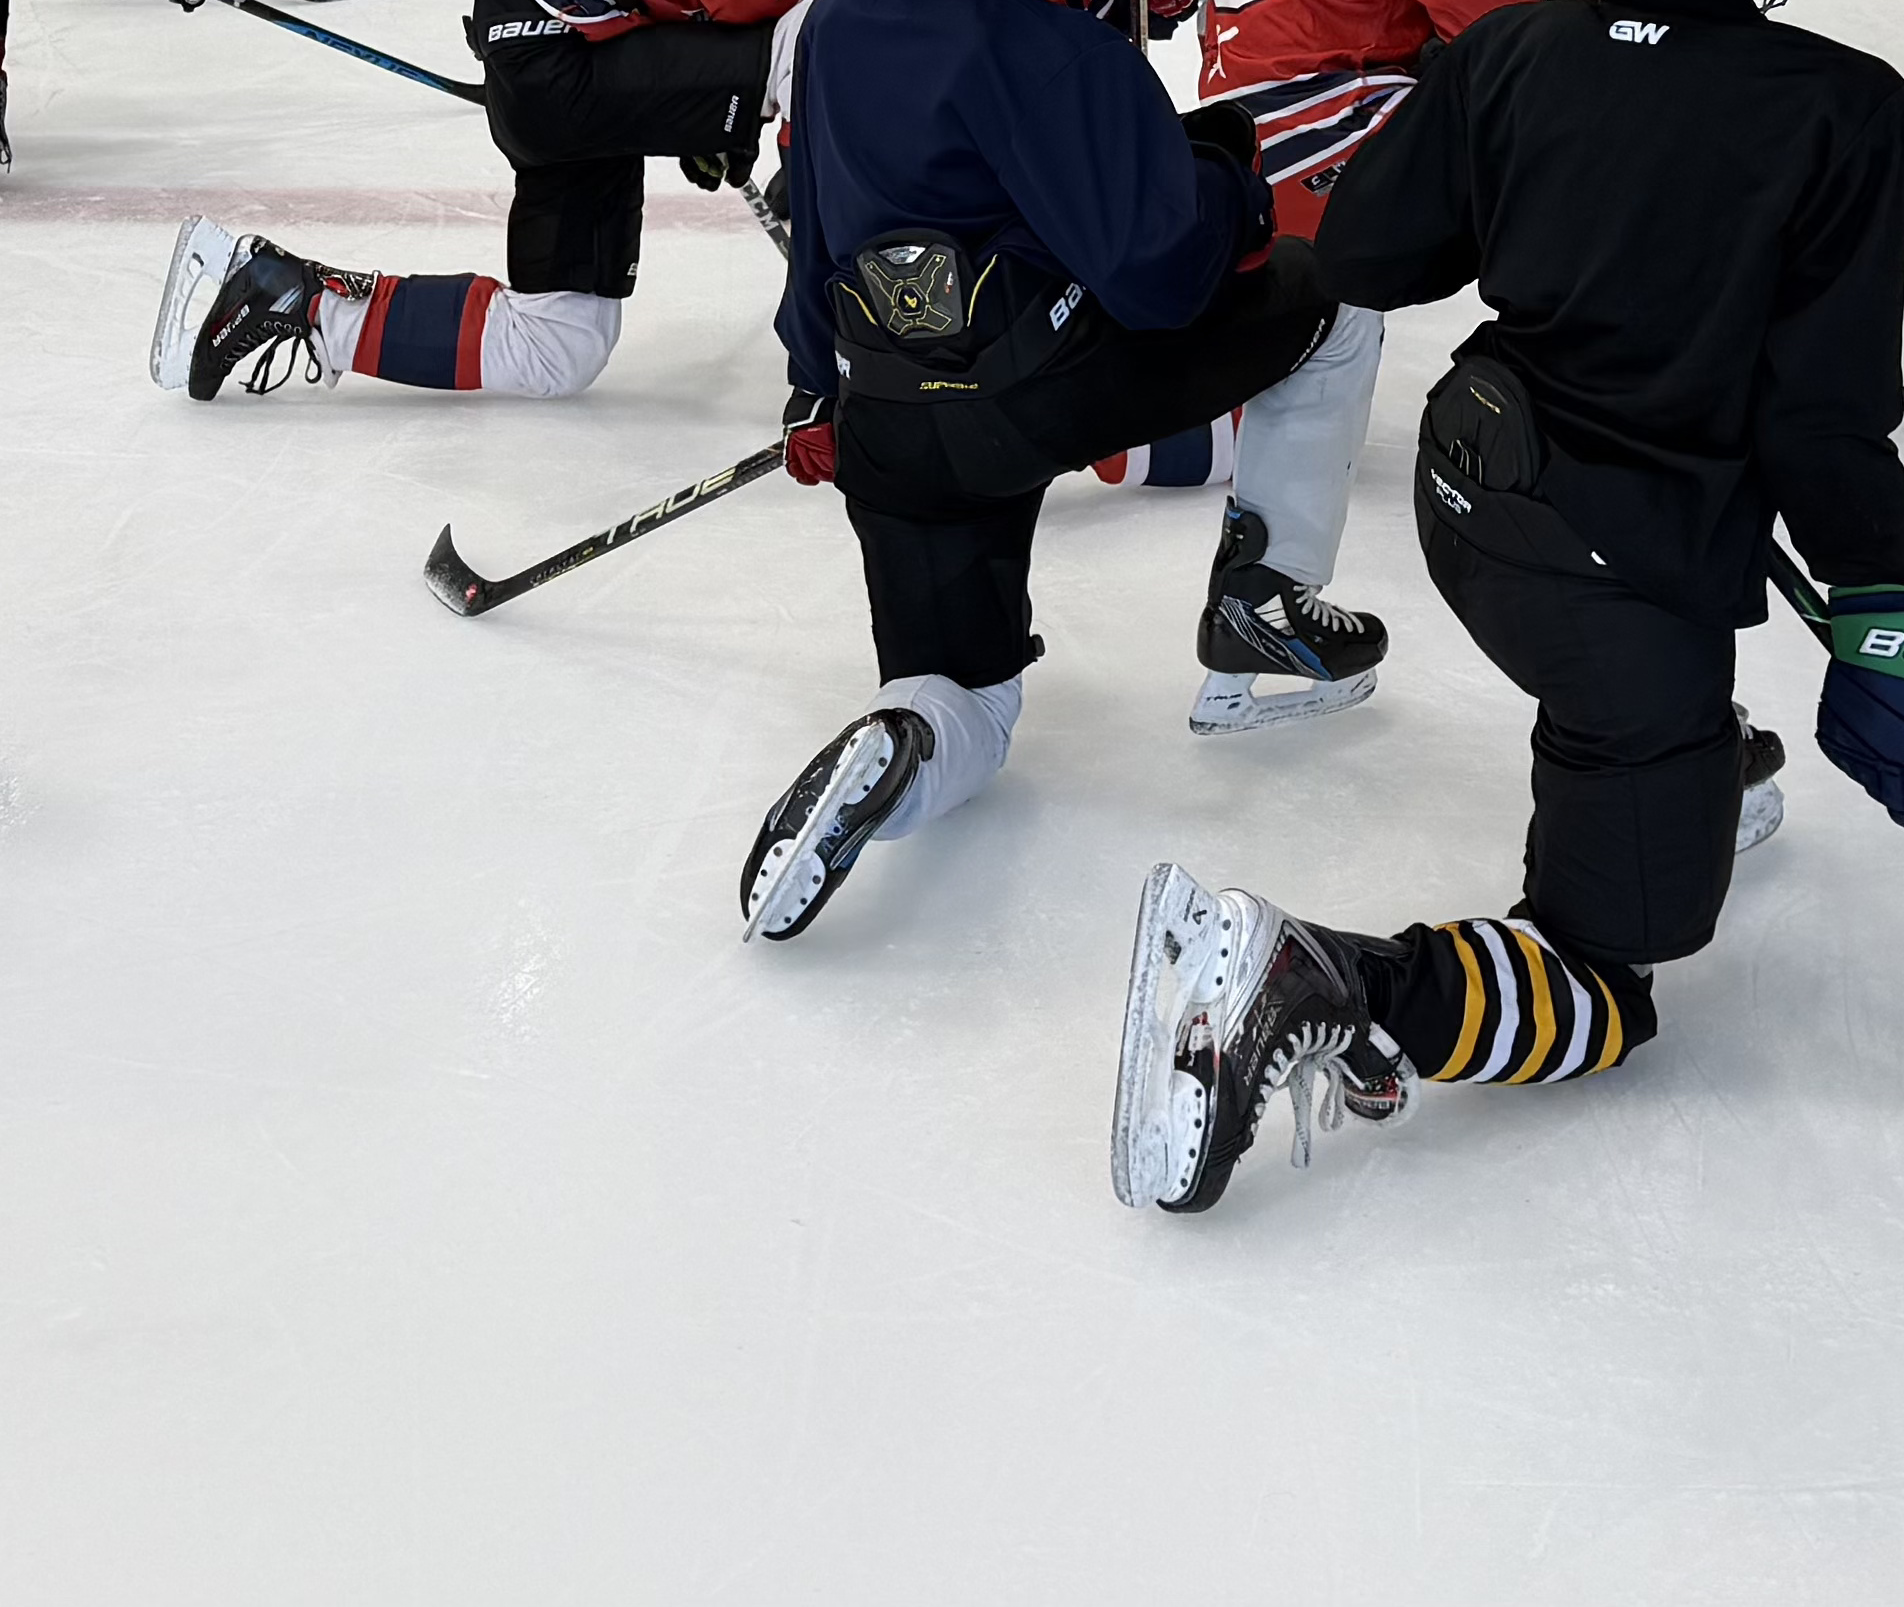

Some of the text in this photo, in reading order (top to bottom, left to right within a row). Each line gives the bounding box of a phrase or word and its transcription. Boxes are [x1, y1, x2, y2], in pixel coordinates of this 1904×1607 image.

[1608, 19, 1671, 46] GW
[723, 94, 740, 133] BAUER
[211, 302, 253, 351] BAUER
[591, 466, 737, 546] TRUE
[1430, 468, 1472, 514] VECTOR
[1436, 486, 1462, 515] PLUS
